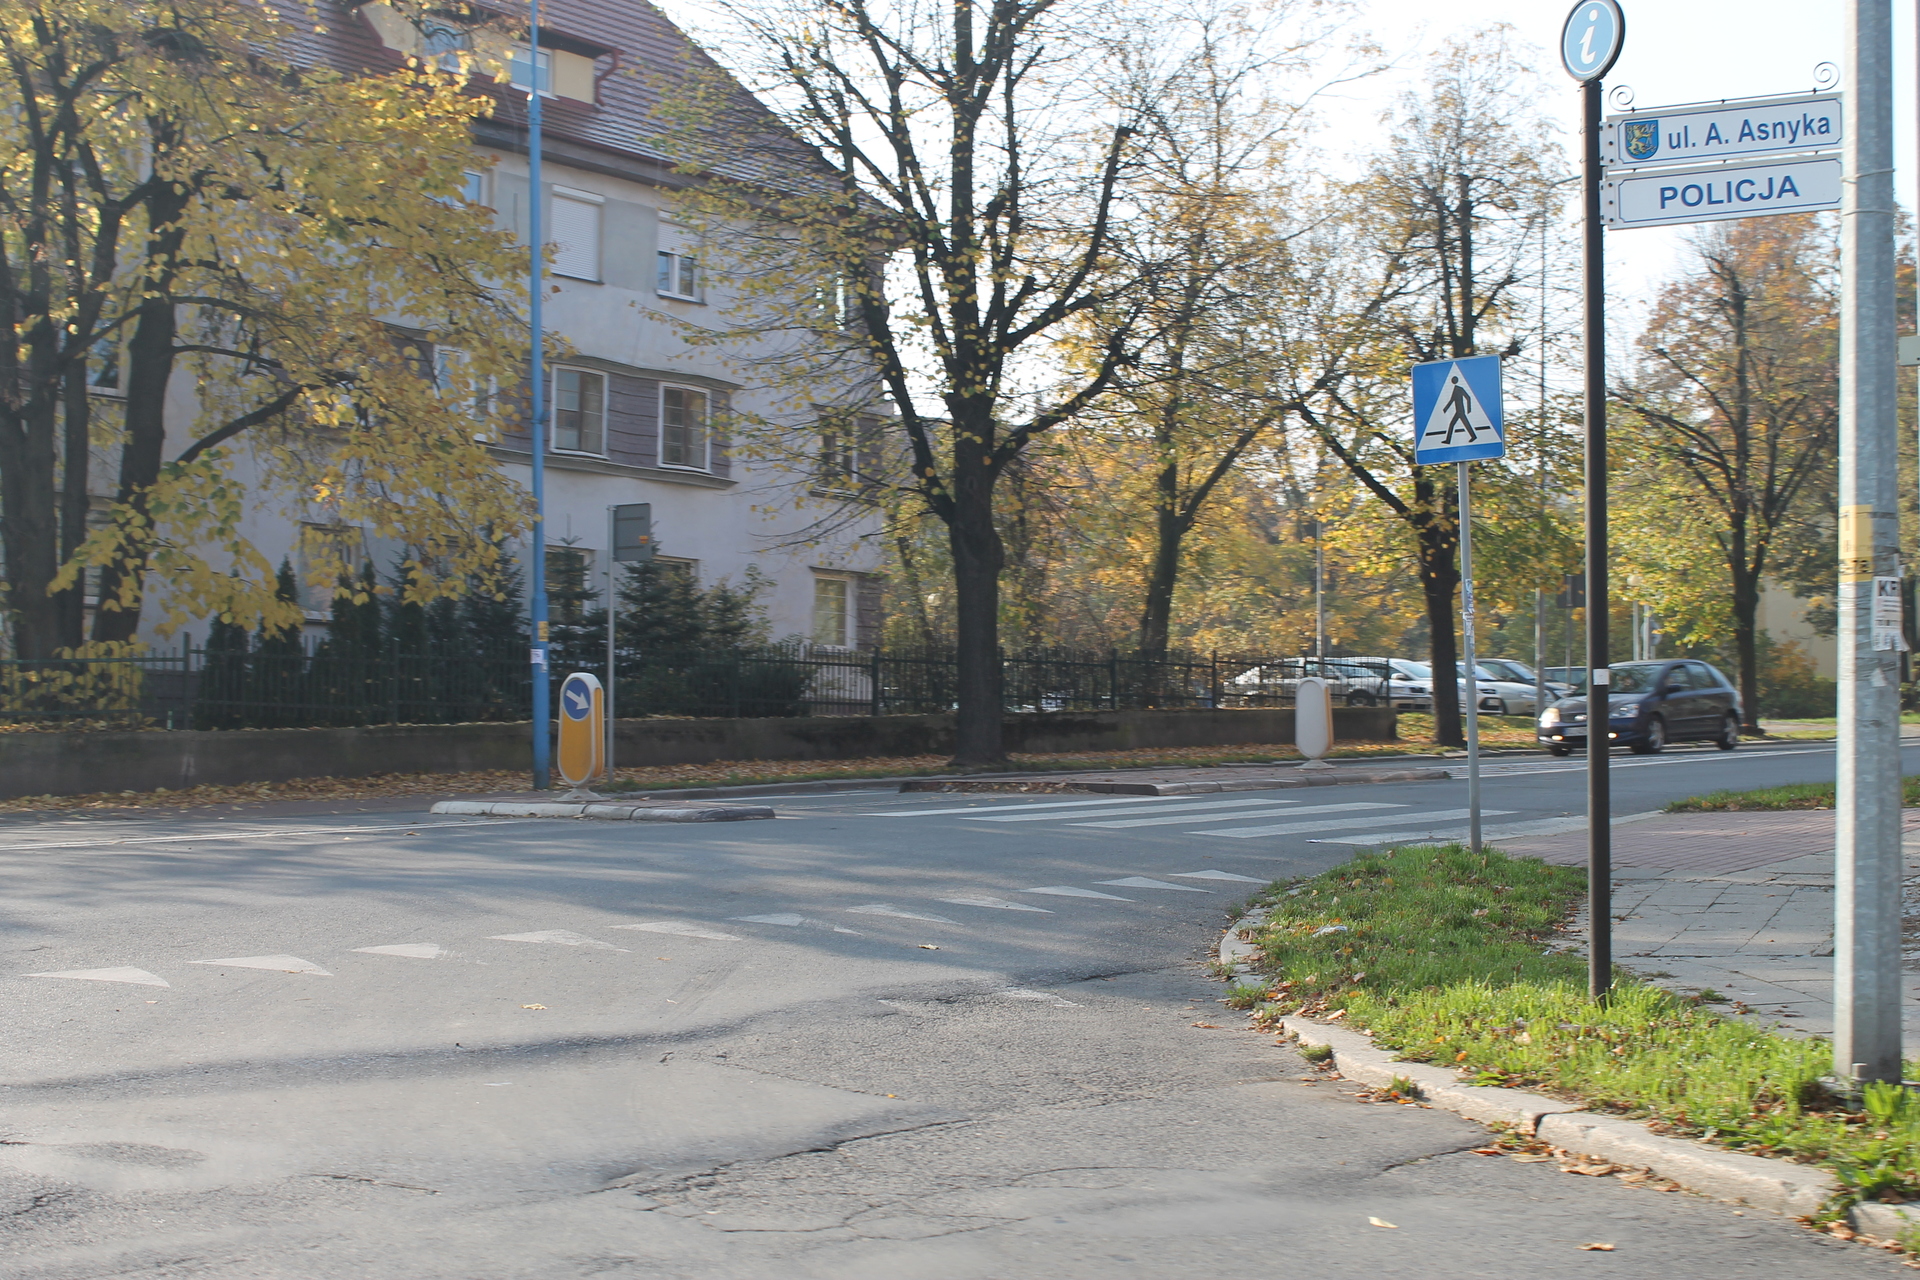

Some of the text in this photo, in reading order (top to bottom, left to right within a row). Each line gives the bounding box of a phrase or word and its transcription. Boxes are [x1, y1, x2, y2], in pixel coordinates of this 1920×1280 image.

[1668, 113, 1831, 149] ul. A. Asnyka
[1659, 175, 1800, 210] POLICJA
